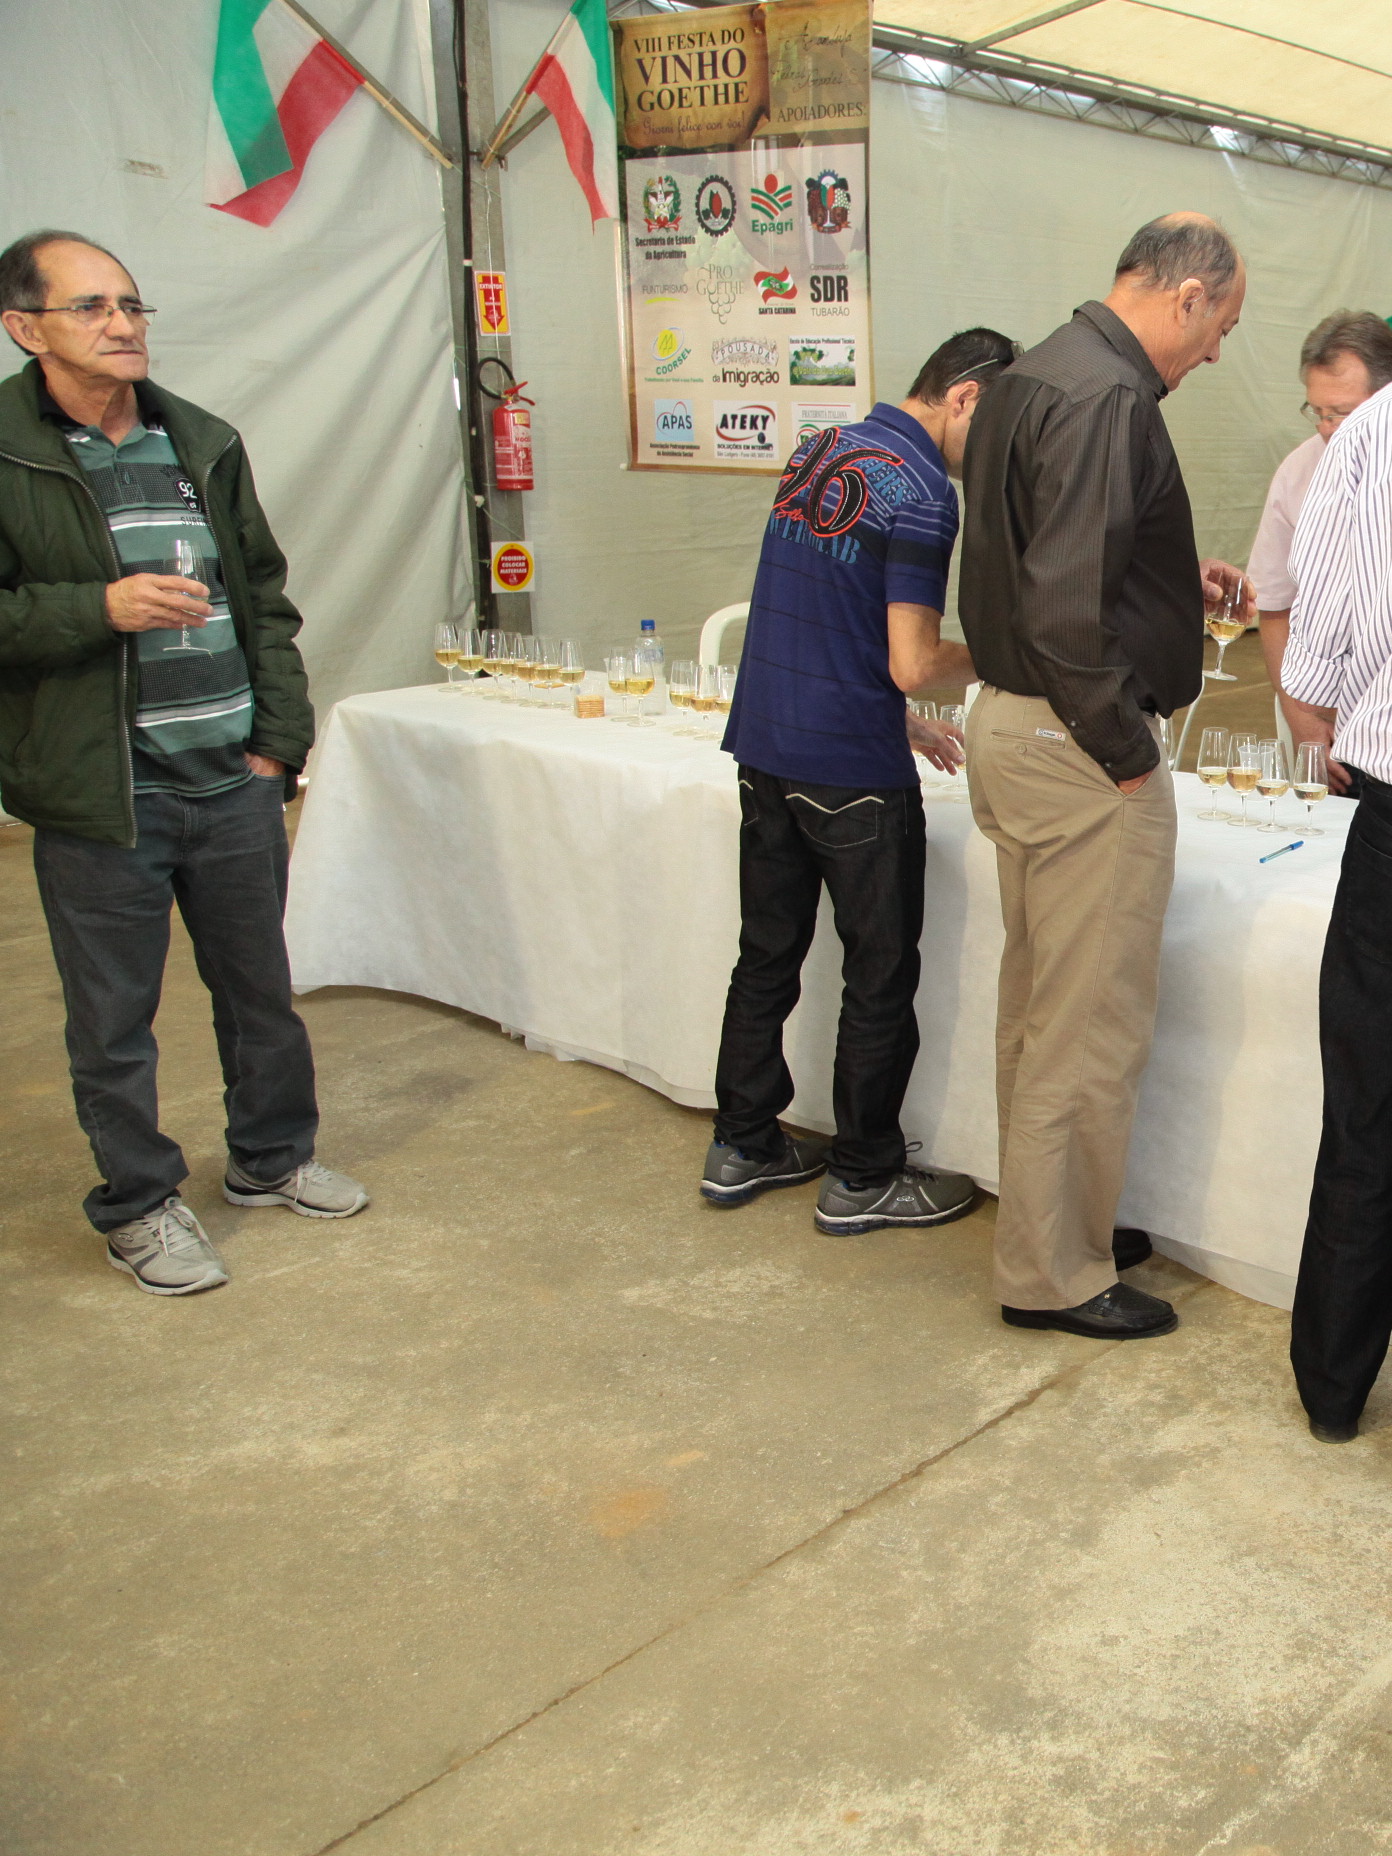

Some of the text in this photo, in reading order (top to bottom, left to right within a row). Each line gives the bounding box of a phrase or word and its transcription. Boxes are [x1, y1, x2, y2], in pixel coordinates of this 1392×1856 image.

[634, 27, 745, 53] VIII FESTA DO
[635, 48, 747, 86] VINHO
[637, 81, 749, 112] GOETHE
[751, 218, 794, 236] Epagri
[635, 235, 696, 247] Secretaria de Estado
[645, 250, 687, 260] da Agricultura
[708, 264, 733, 280] PRO
[810, 274, 849, 303] SDR
[758, 307, 797, 315] SANTA CATARINA
[811, 306, 850, 317] TUBARÃO
[721, 342, 770, 359] POUSADA
[656, 347, 692, 375] COORSEL
[712, 367, 780, 387] da Imigração
[662, 415, 693, 430] APAS
[719, 413, 770, 430] ATEKY
[178, 481, 198, 499] 92
